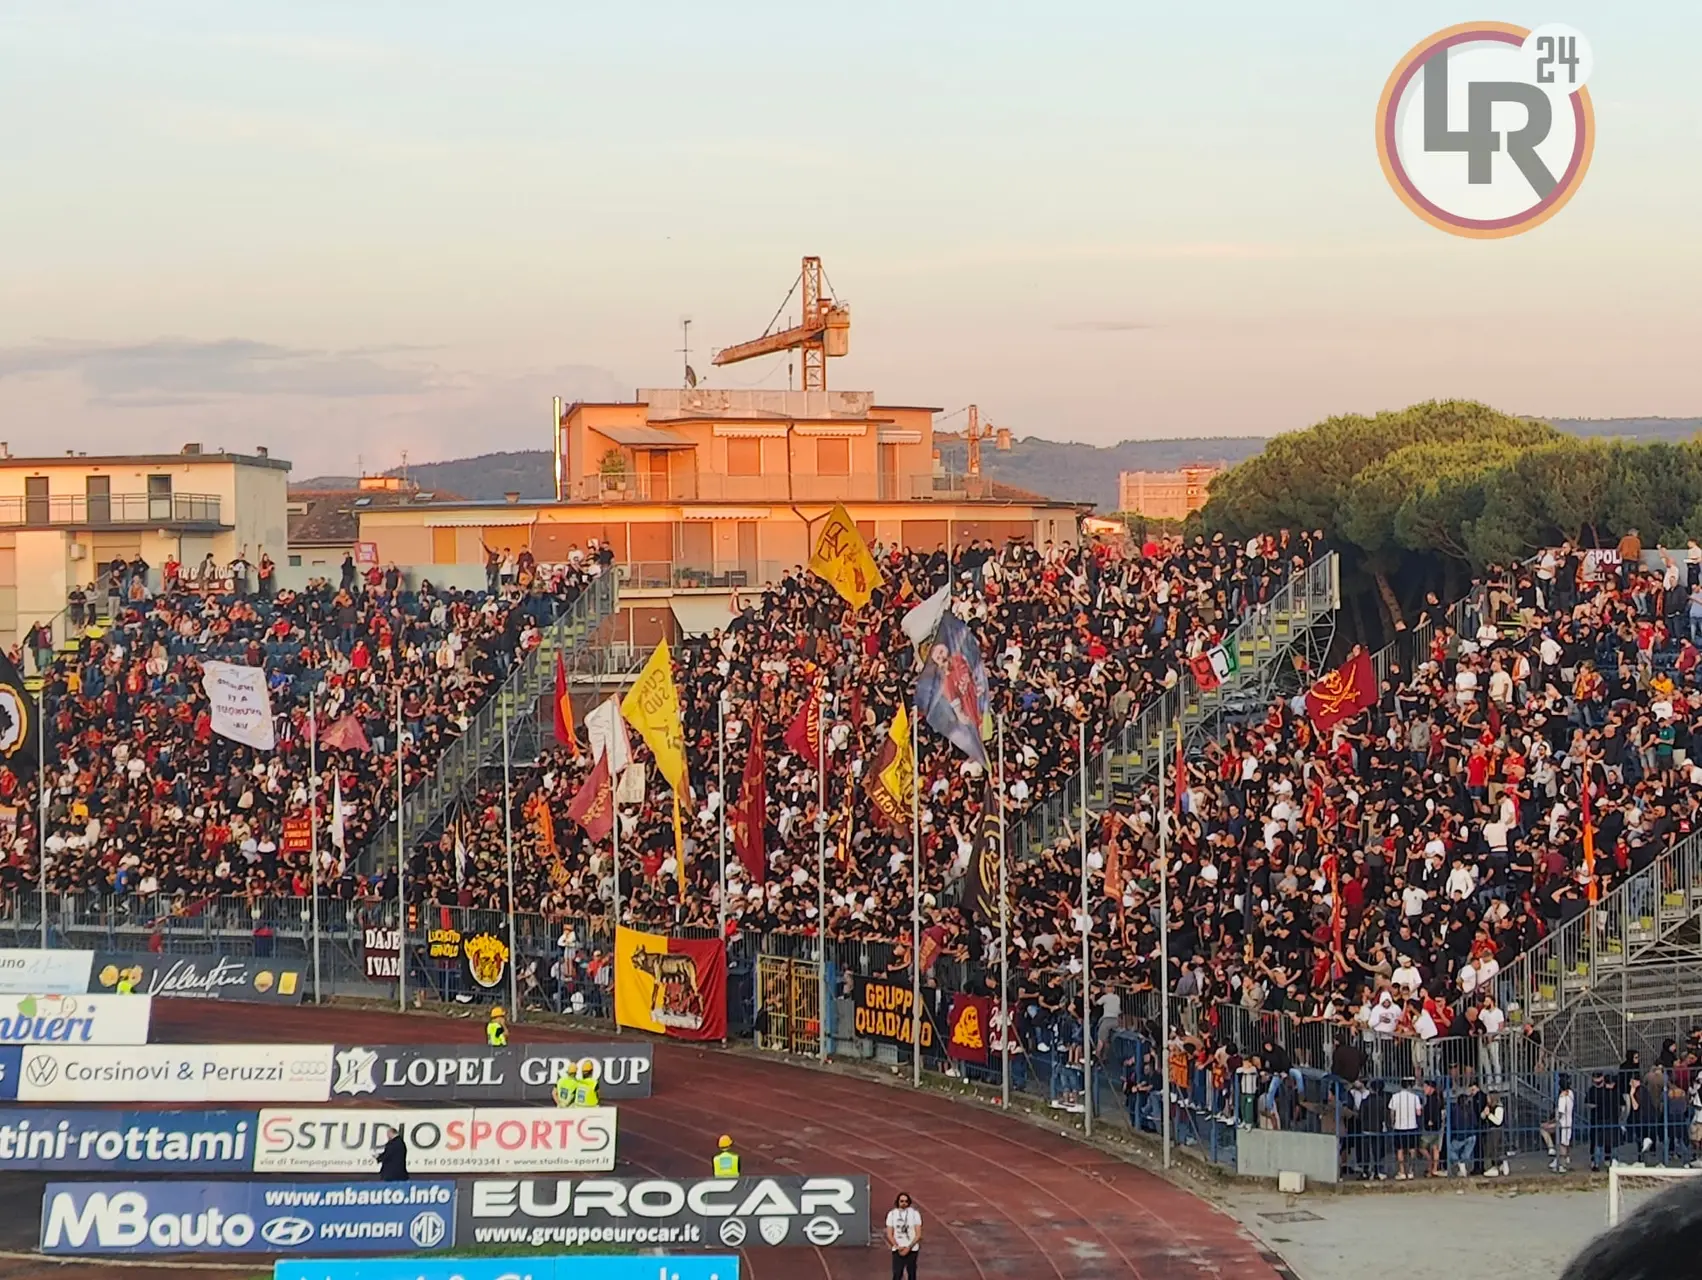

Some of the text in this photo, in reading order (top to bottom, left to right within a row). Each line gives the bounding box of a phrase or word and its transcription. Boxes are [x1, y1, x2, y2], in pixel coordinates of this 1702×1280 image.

[1589, 550, 1622, 564] SPOL
[855, 1007, 932, 1047] QUADAO
[65, 1054, 284, 1082] Corsinovi & Peruzzi
[383, 1057, 651, 1087] LOPEL GROUP
[265, 1185, 451, 1207] www.mbauto.info
[472, 1178, 856, 1218] EUROCAR
[44, 1191, 255, 1248] MBauto
[320, 1221, 404, 1239] HYUNDAI
[474, 1223, 701, 1247] www.gruppoeurocar.it
